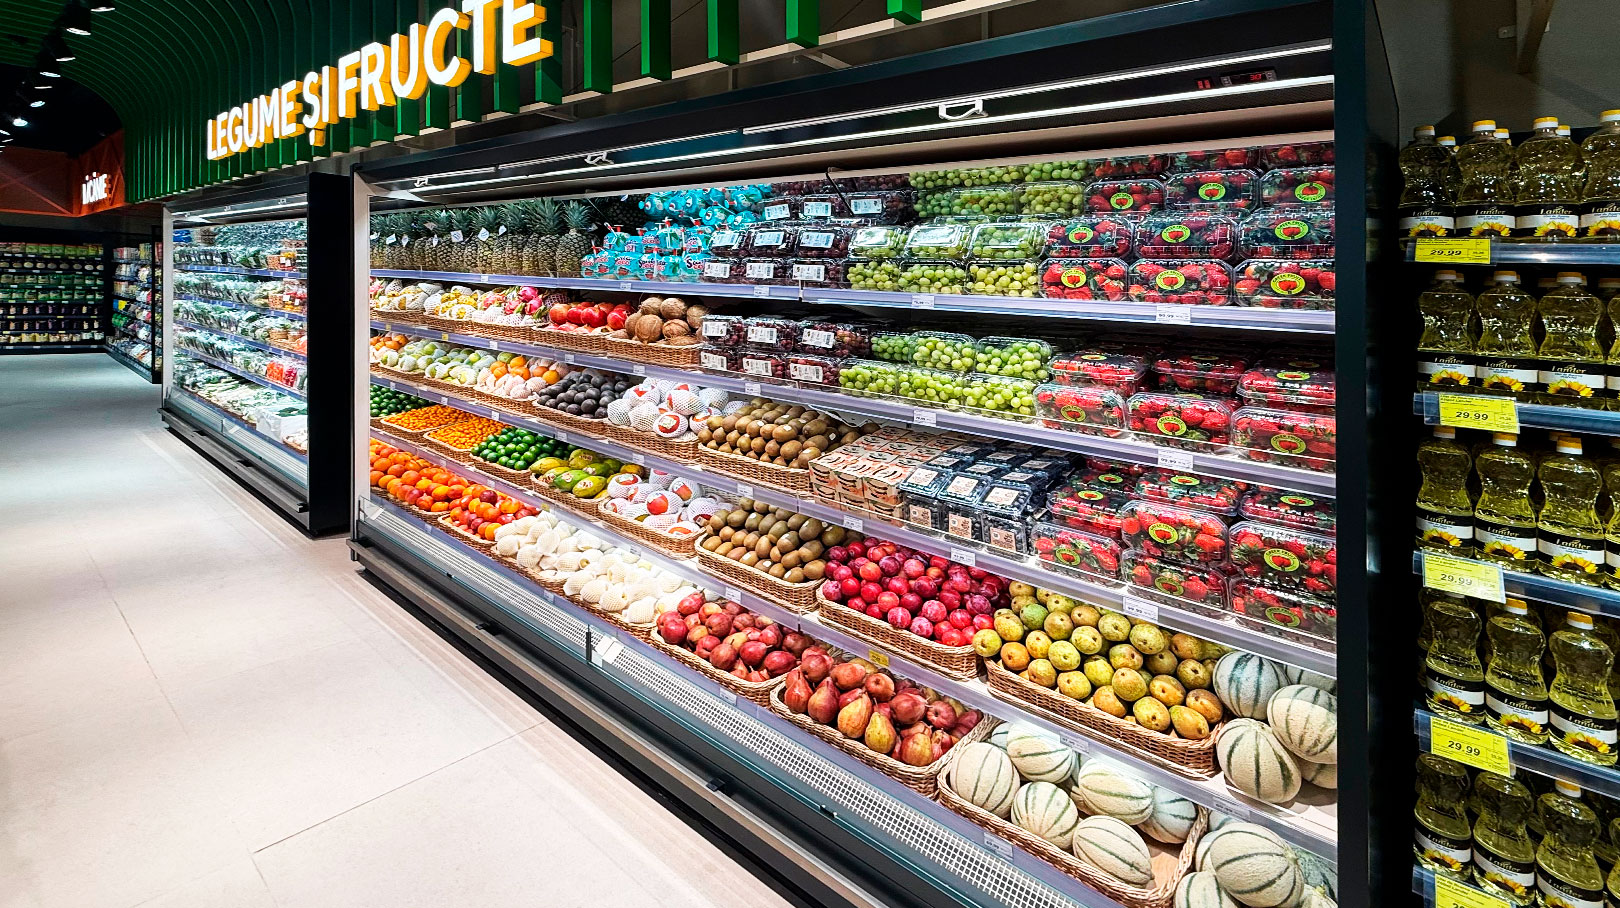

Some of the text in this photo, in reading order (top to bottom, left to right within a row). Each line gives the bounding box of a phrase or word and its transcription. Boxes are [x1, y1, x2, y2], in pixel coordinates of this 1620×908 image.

[207, 79, 302, 160] LEGUME
[338, 0, 549, 119] FRUCTE
[1455, 411, 1488, 420] 29.99
[1440, 573, 1473, 586] 29.99
[1447, 740, 1480, 756] 29.99
